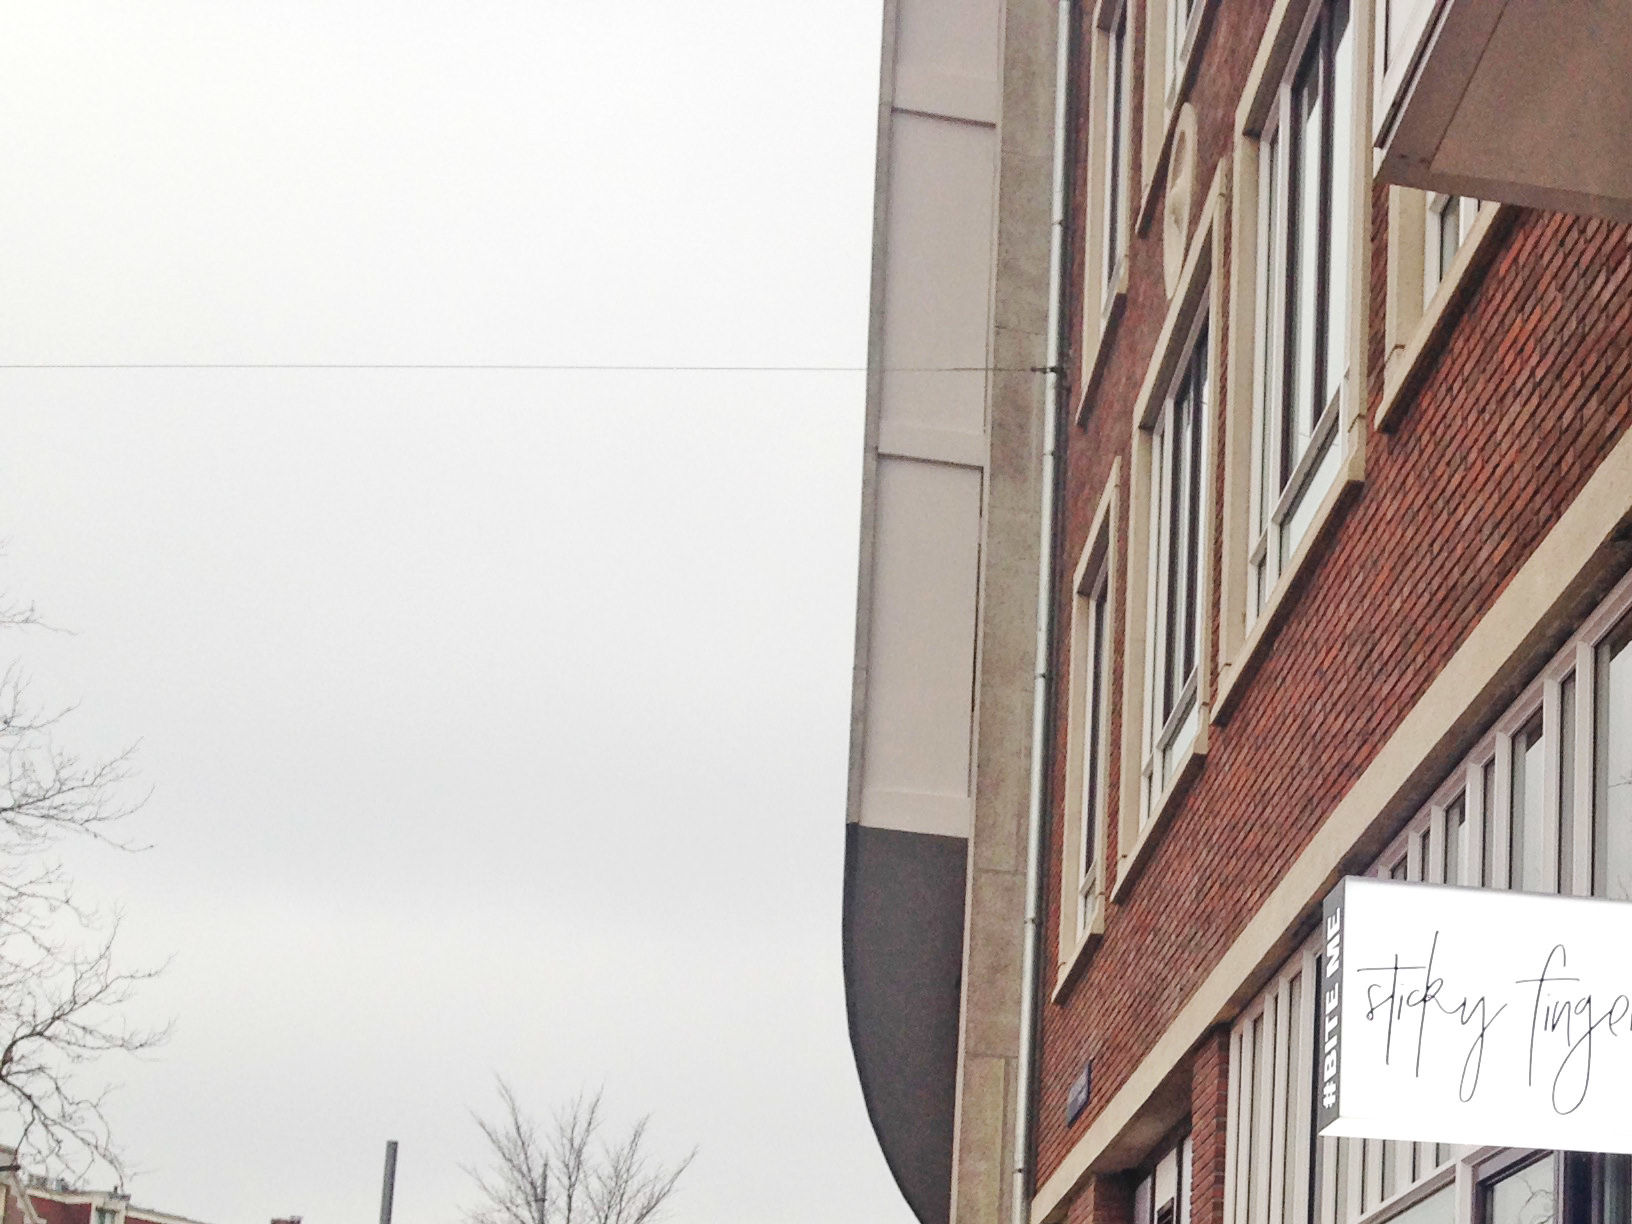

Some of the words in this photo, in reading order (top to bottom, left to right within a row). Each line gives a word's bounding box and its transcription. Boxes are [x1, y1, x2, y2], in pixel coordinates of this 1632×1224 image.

[1326, 907, 1341, 979] ME
[1322, 982, 1339, 1110] #BITE
[1356, 930, 1508, 1103] sticky
